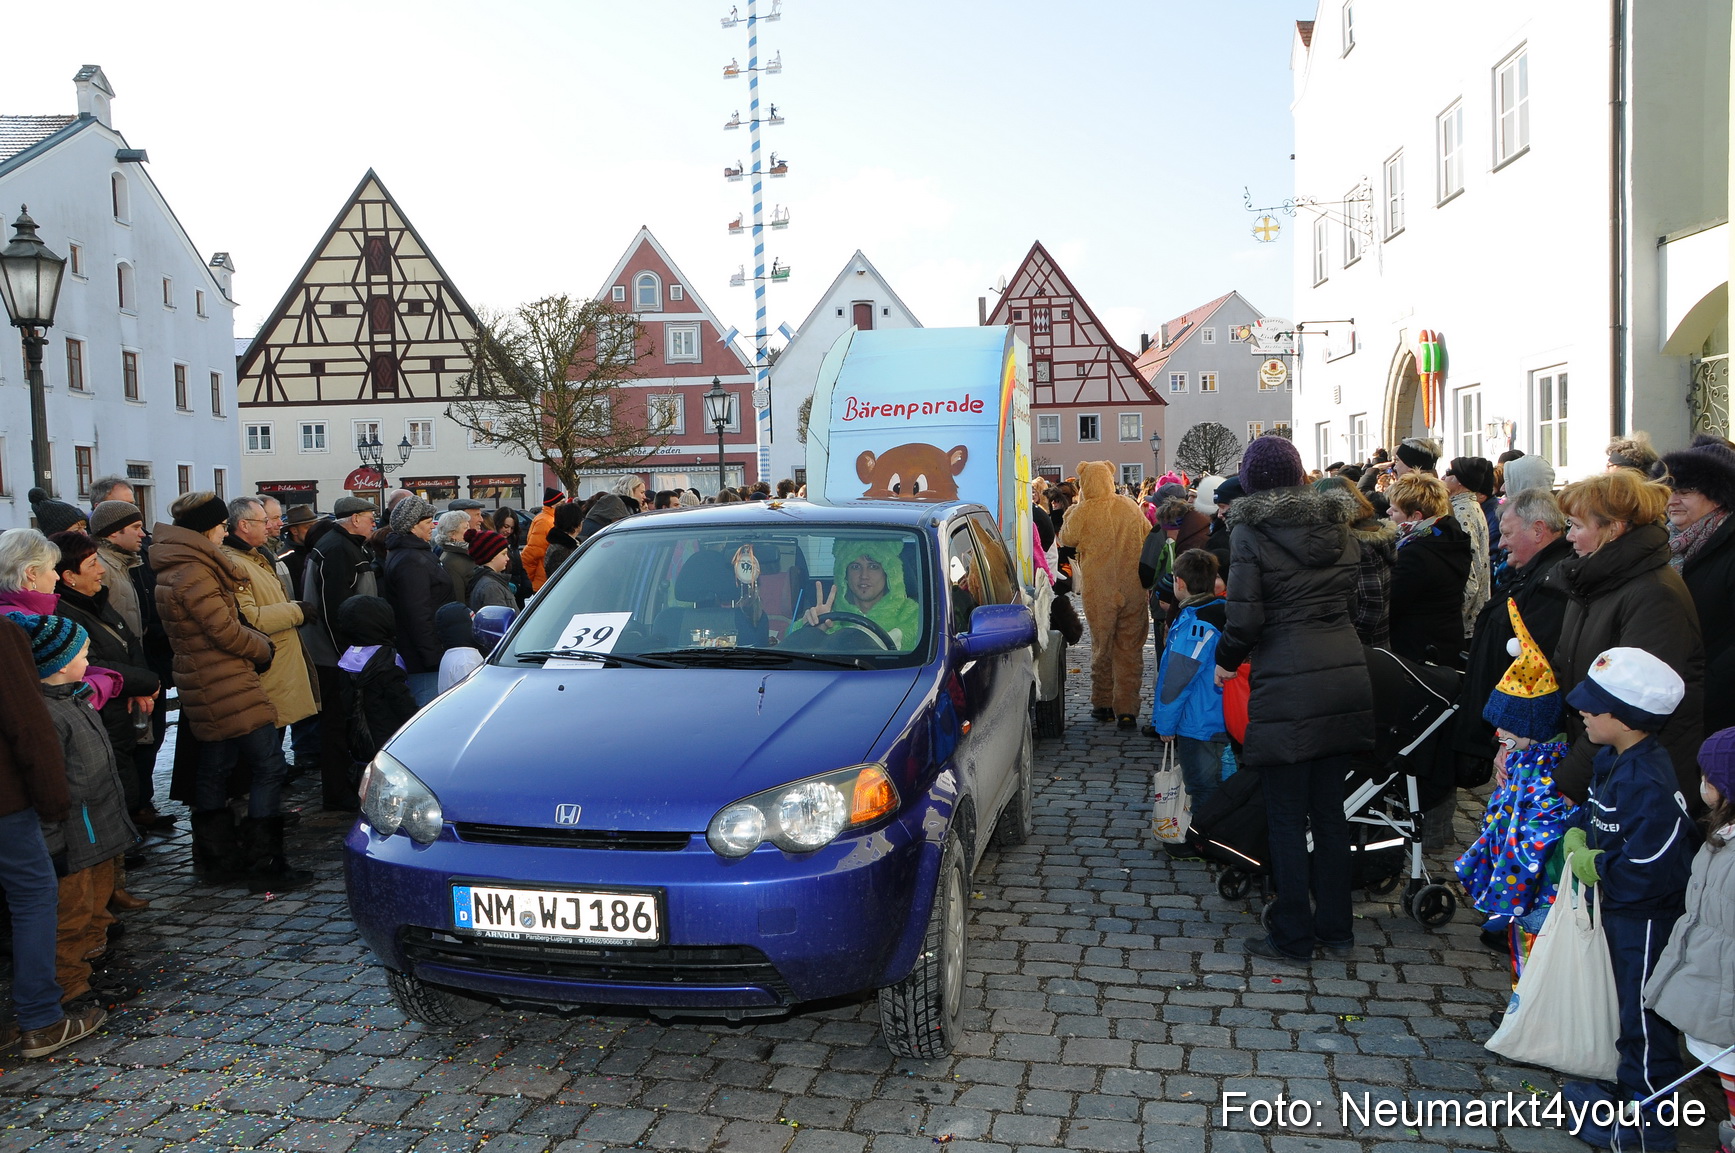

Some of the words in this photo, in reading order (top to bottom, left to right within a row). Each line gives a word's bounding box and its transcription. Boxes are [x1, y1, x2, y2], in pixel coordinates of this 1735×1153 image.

[842, 393, 985, 421] Bärenparade
[561, 626, 614, 649] 39
[459, 909, 468, 921] D
[474, 892, 515, 926] NM
[484, 931, 520, 940] ARNOLD
